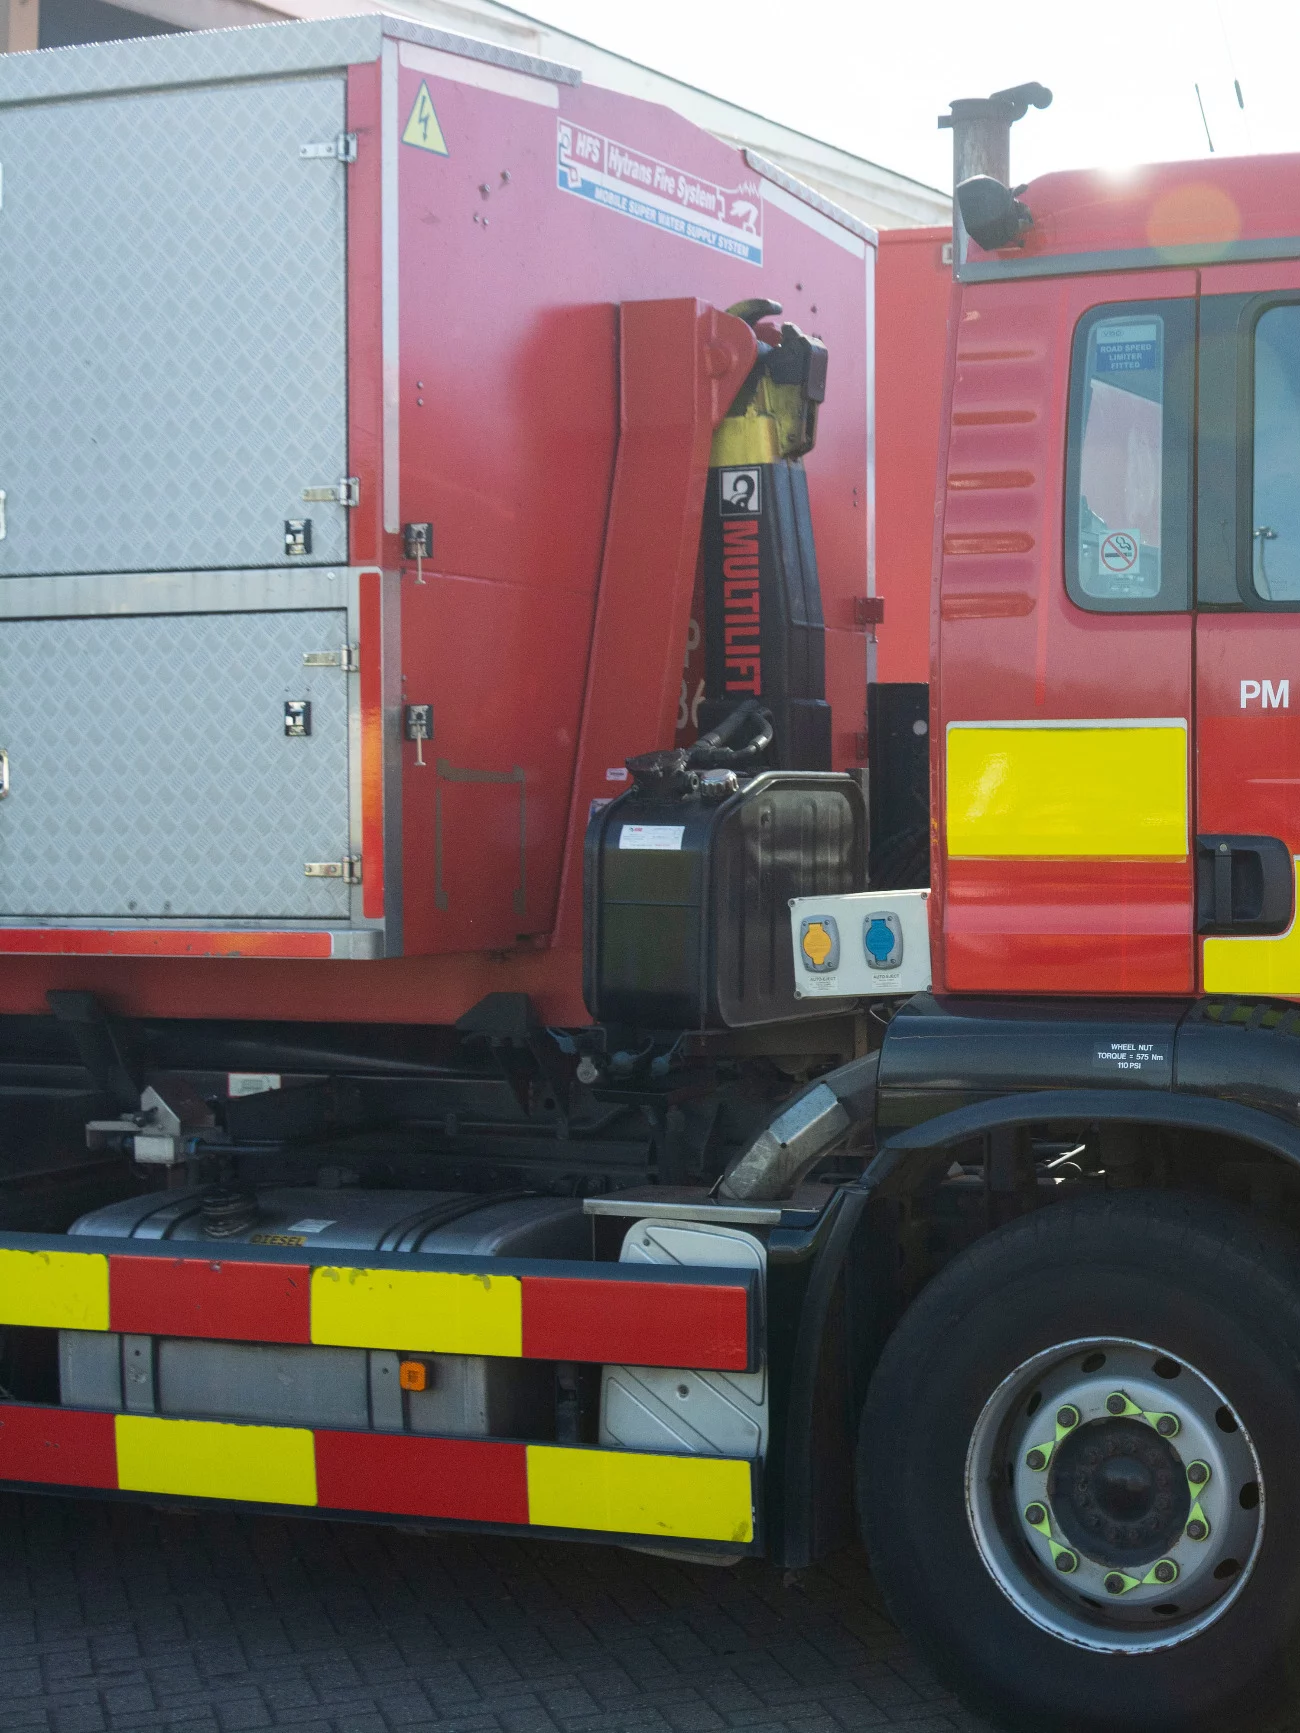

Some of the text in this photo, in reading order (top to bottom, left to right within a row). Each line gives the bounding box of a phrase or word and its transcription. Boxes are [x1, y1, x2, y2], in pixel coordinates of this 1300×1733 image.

[575, 132, 601, 163] HFS
[608, 146, 717, 210] Hytrans Fire System
[594, 187, 750, 257] MOBILE SUPER WATER SUPPLY SYSTEM
[1100, 343, 1152, 353] ROAD SPEED
[1109, 352, 1143, 361] LIMITER
[1111, 361, 1140, 370] FITTED
[722, 519, 762, 696] MULTILIFT
[1240, 679, 1290, 709] PM
[1097, 1052, 1127, 1060] TORQUE
[1111, 1043, 1136, 1051] WHEEL
